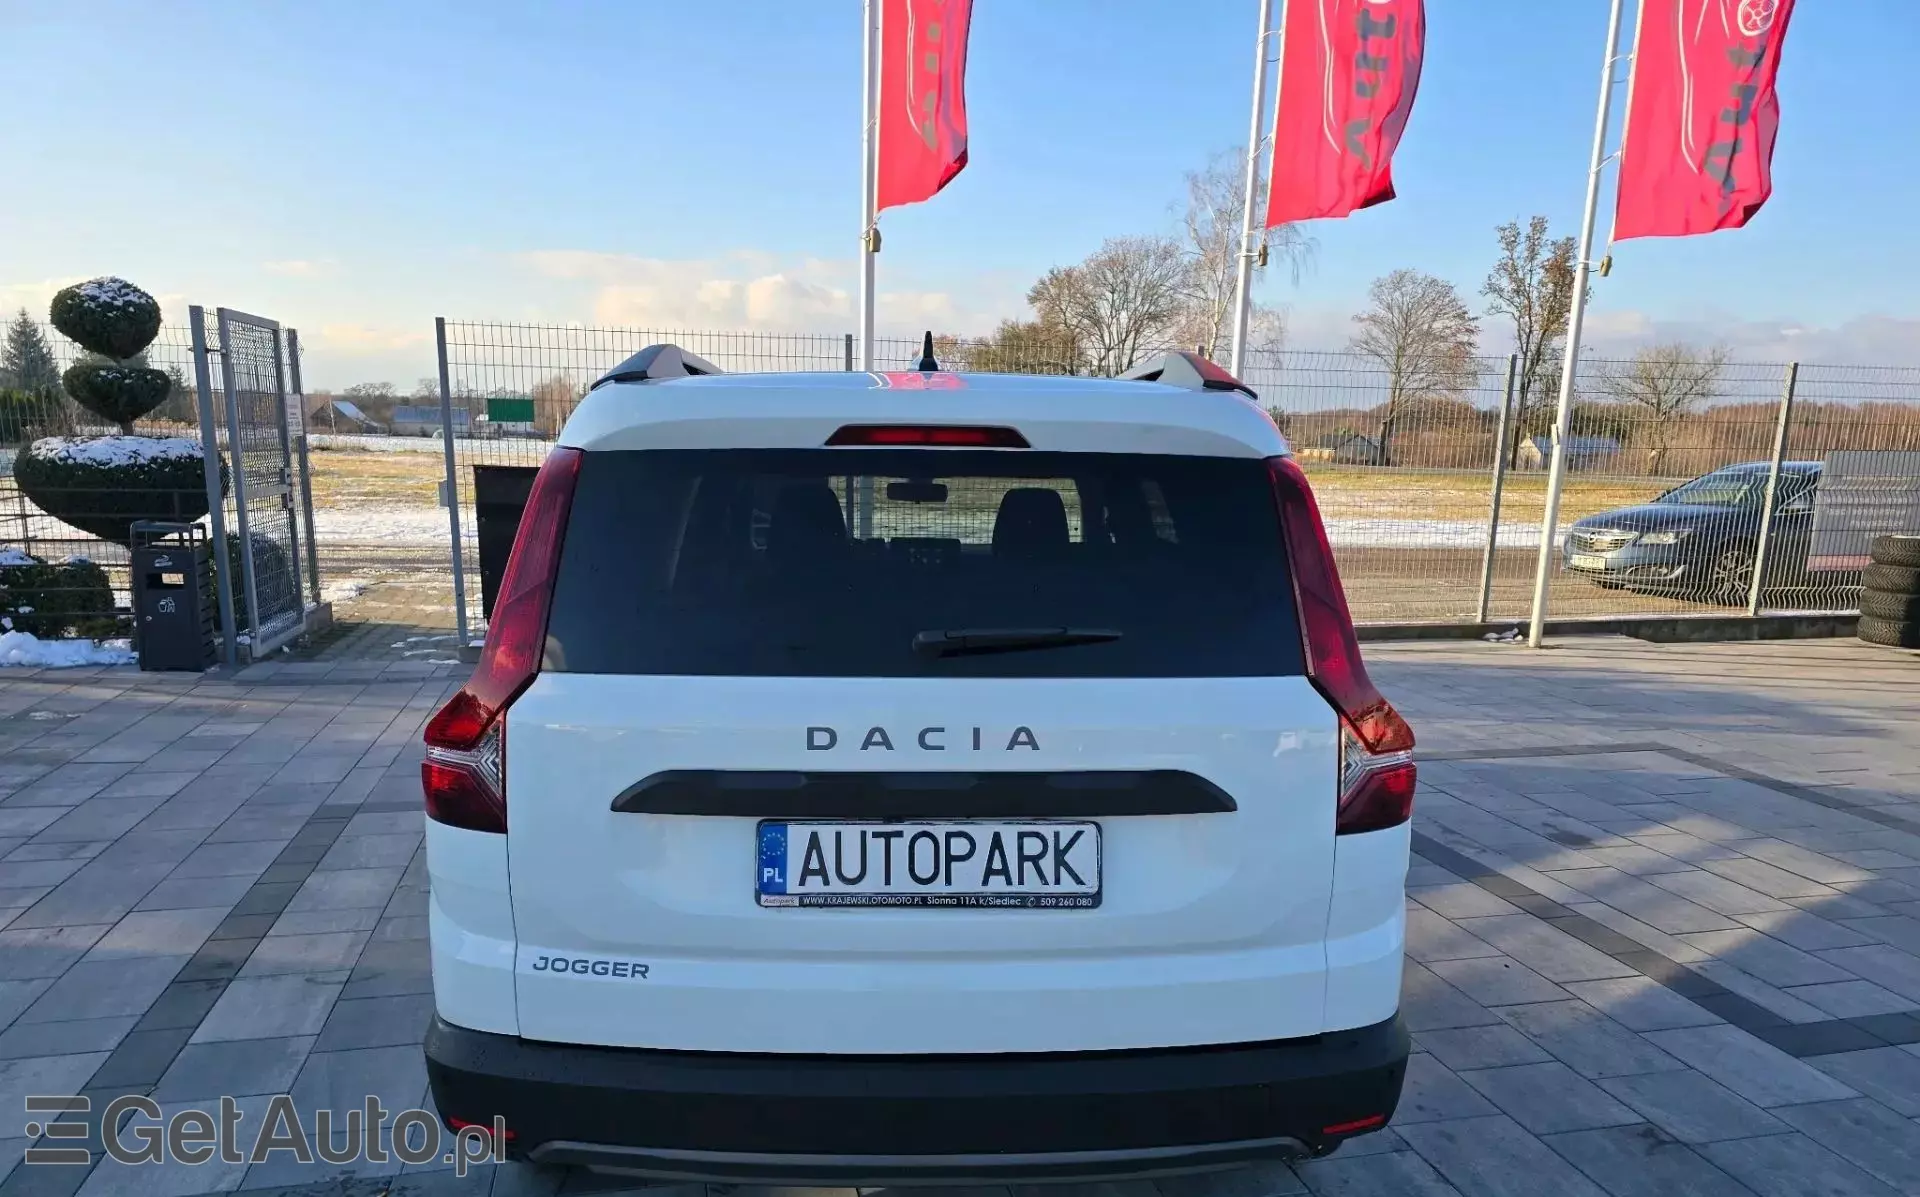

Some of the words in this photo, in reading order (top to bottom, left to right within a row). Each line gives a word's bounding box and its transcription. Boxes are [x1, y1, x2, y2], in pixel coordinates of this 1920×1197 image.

[806, 726, 1041, 751] DACIA
[798, 829, 1087, 888] AUTOPARK
[763, 867, 784, 884] PL
[803, 896, 922, 905] WWW.KRAJEWSKI.OTOMOTO.PL
[960, 896, 977, 905] 11A
[1040, 897, 1056, 906] 509
[1058, 897, 1074, 906] 260
[1076, 897, 1093, 906] 080
[532, 956, 650, 979] JOGGER
